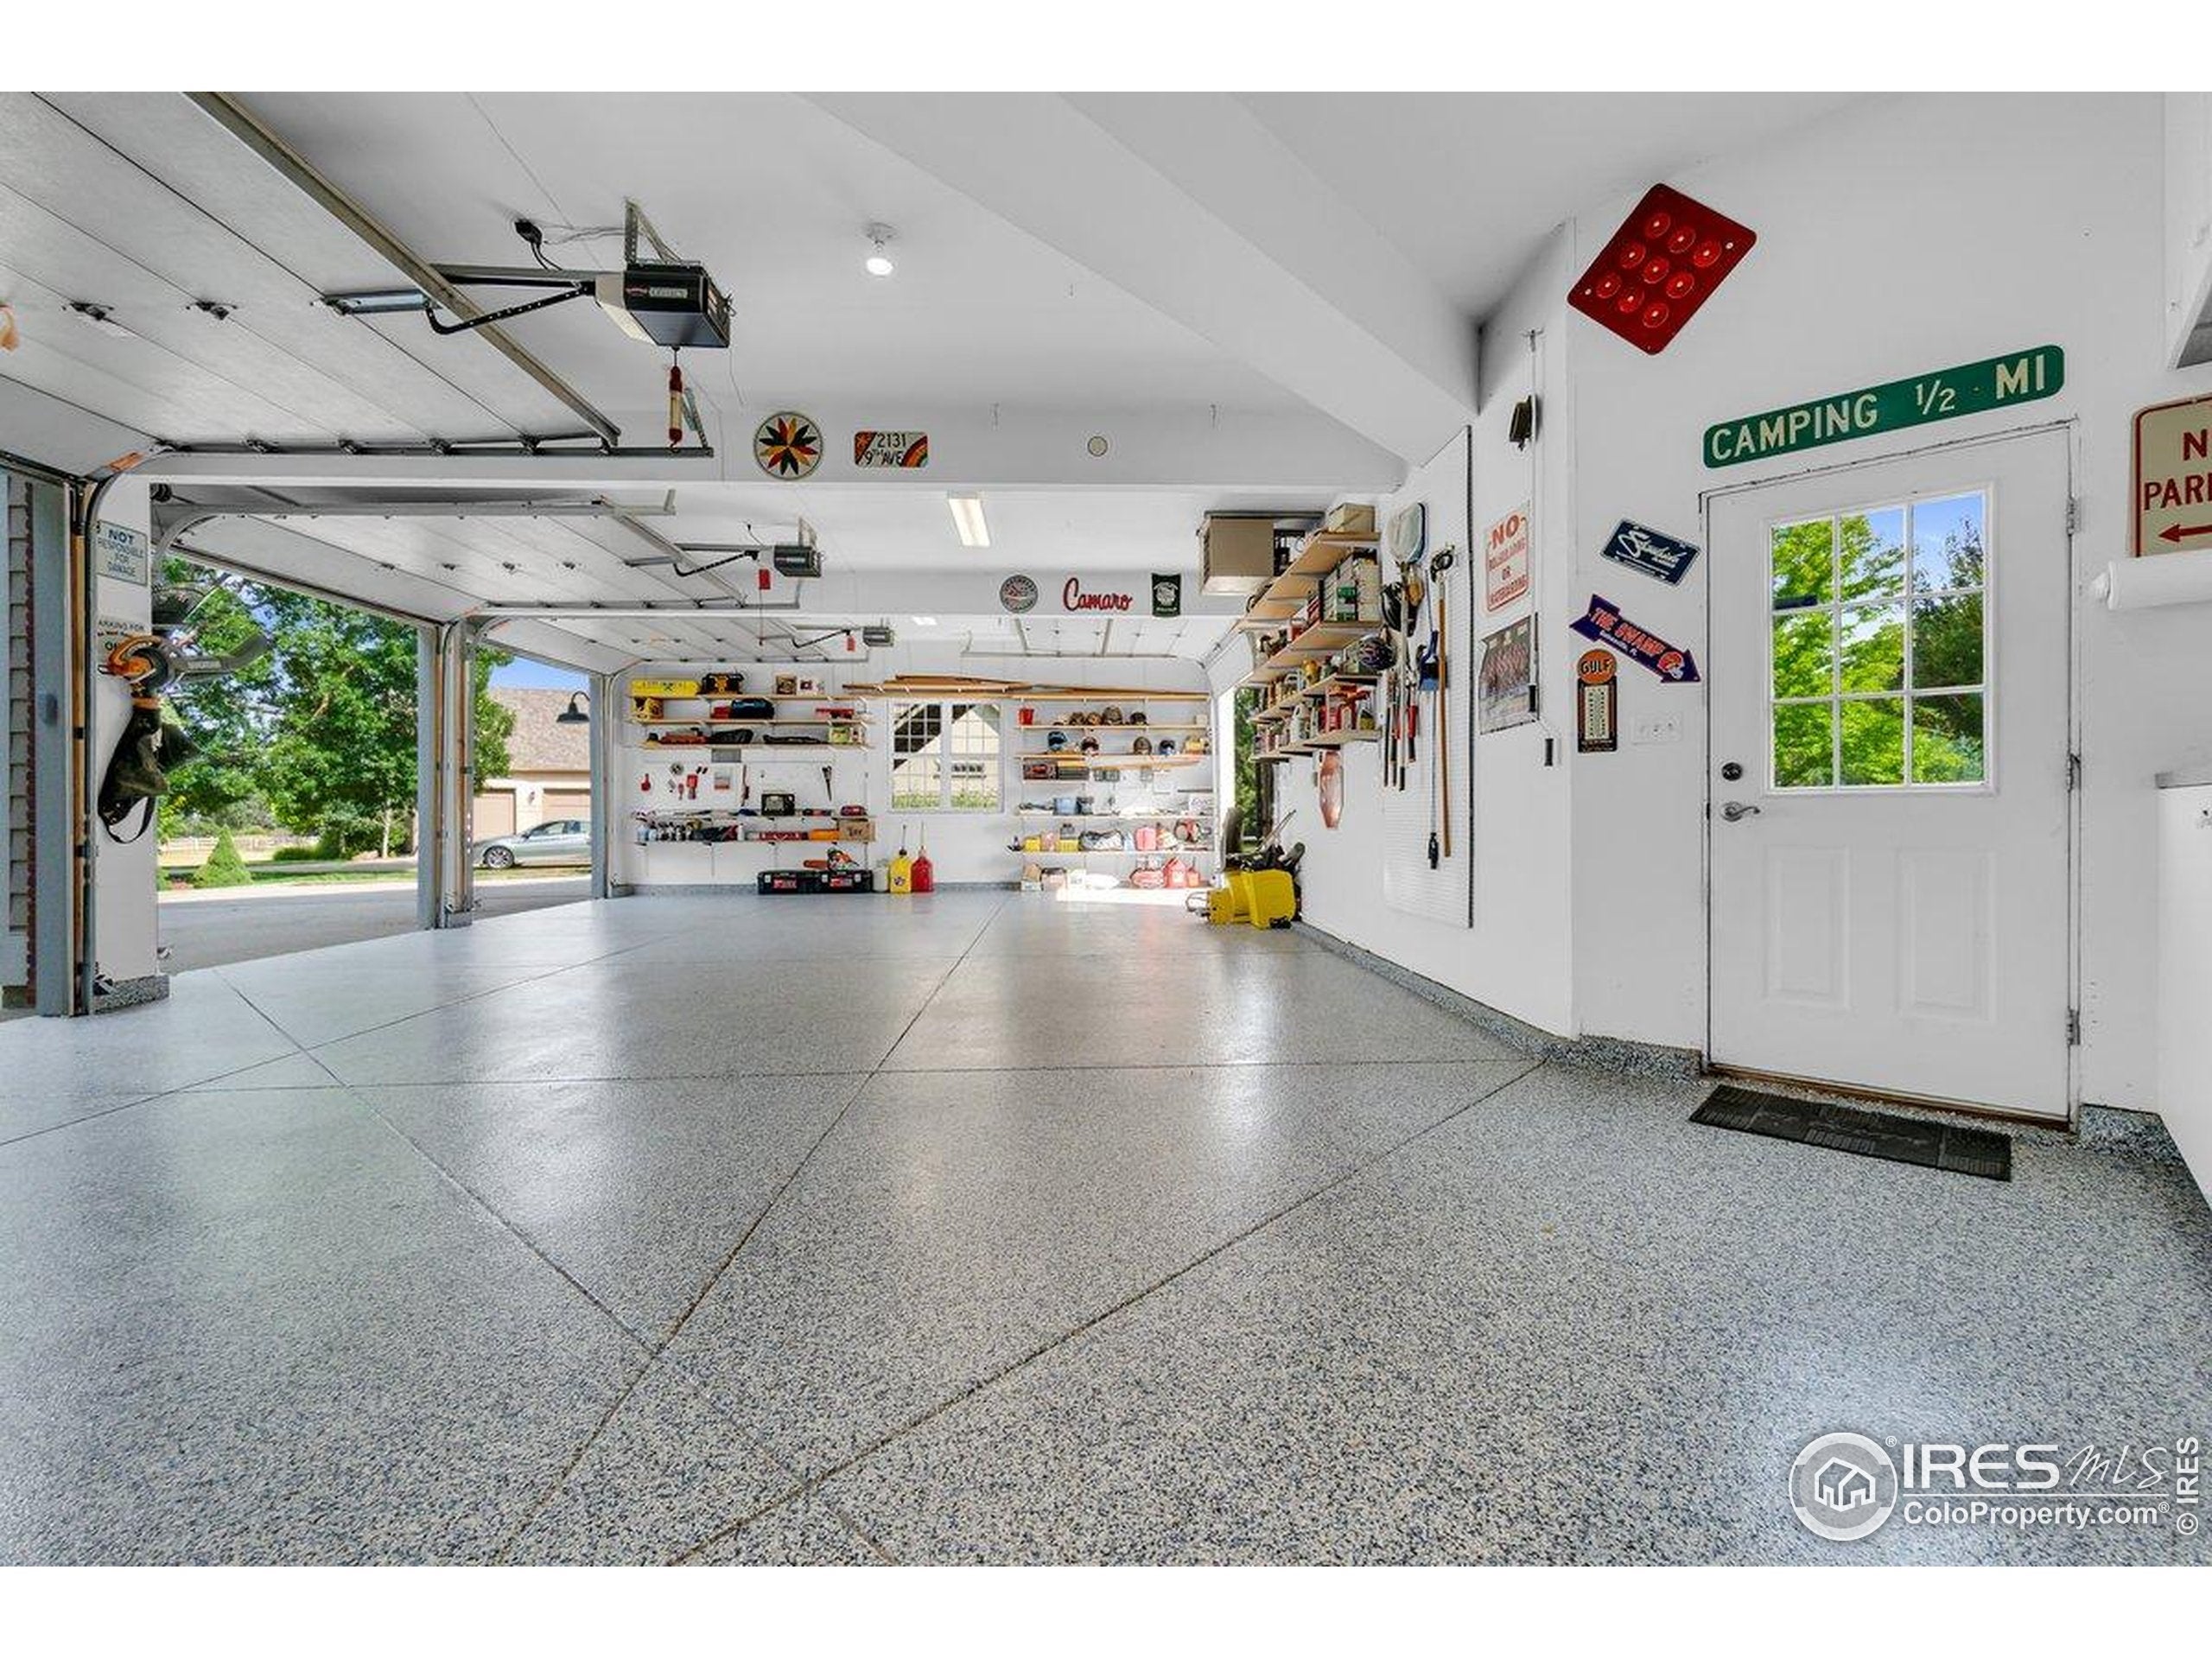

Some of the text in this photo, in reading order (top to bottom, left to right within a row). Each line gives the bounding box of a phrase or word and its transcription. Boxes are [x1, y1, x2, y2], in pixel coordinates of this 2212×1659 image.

[1712, 394, 1878, 461] CAMPING
[1995, 354, 2045, 400] MI
[877, 433, 906, 448] 2131
[2183, 429, 2212, 461] N
[2144, 473, 2212, 511] PAR
[109, 529, 135, 544] NOT
[1491, 514, 1520, 550] NO
[1063, 577, 1133, 612] Camaro
[1590, 607, 1666, 658] THE SWAMP
[1580, 658, 1613, 675] GULF
